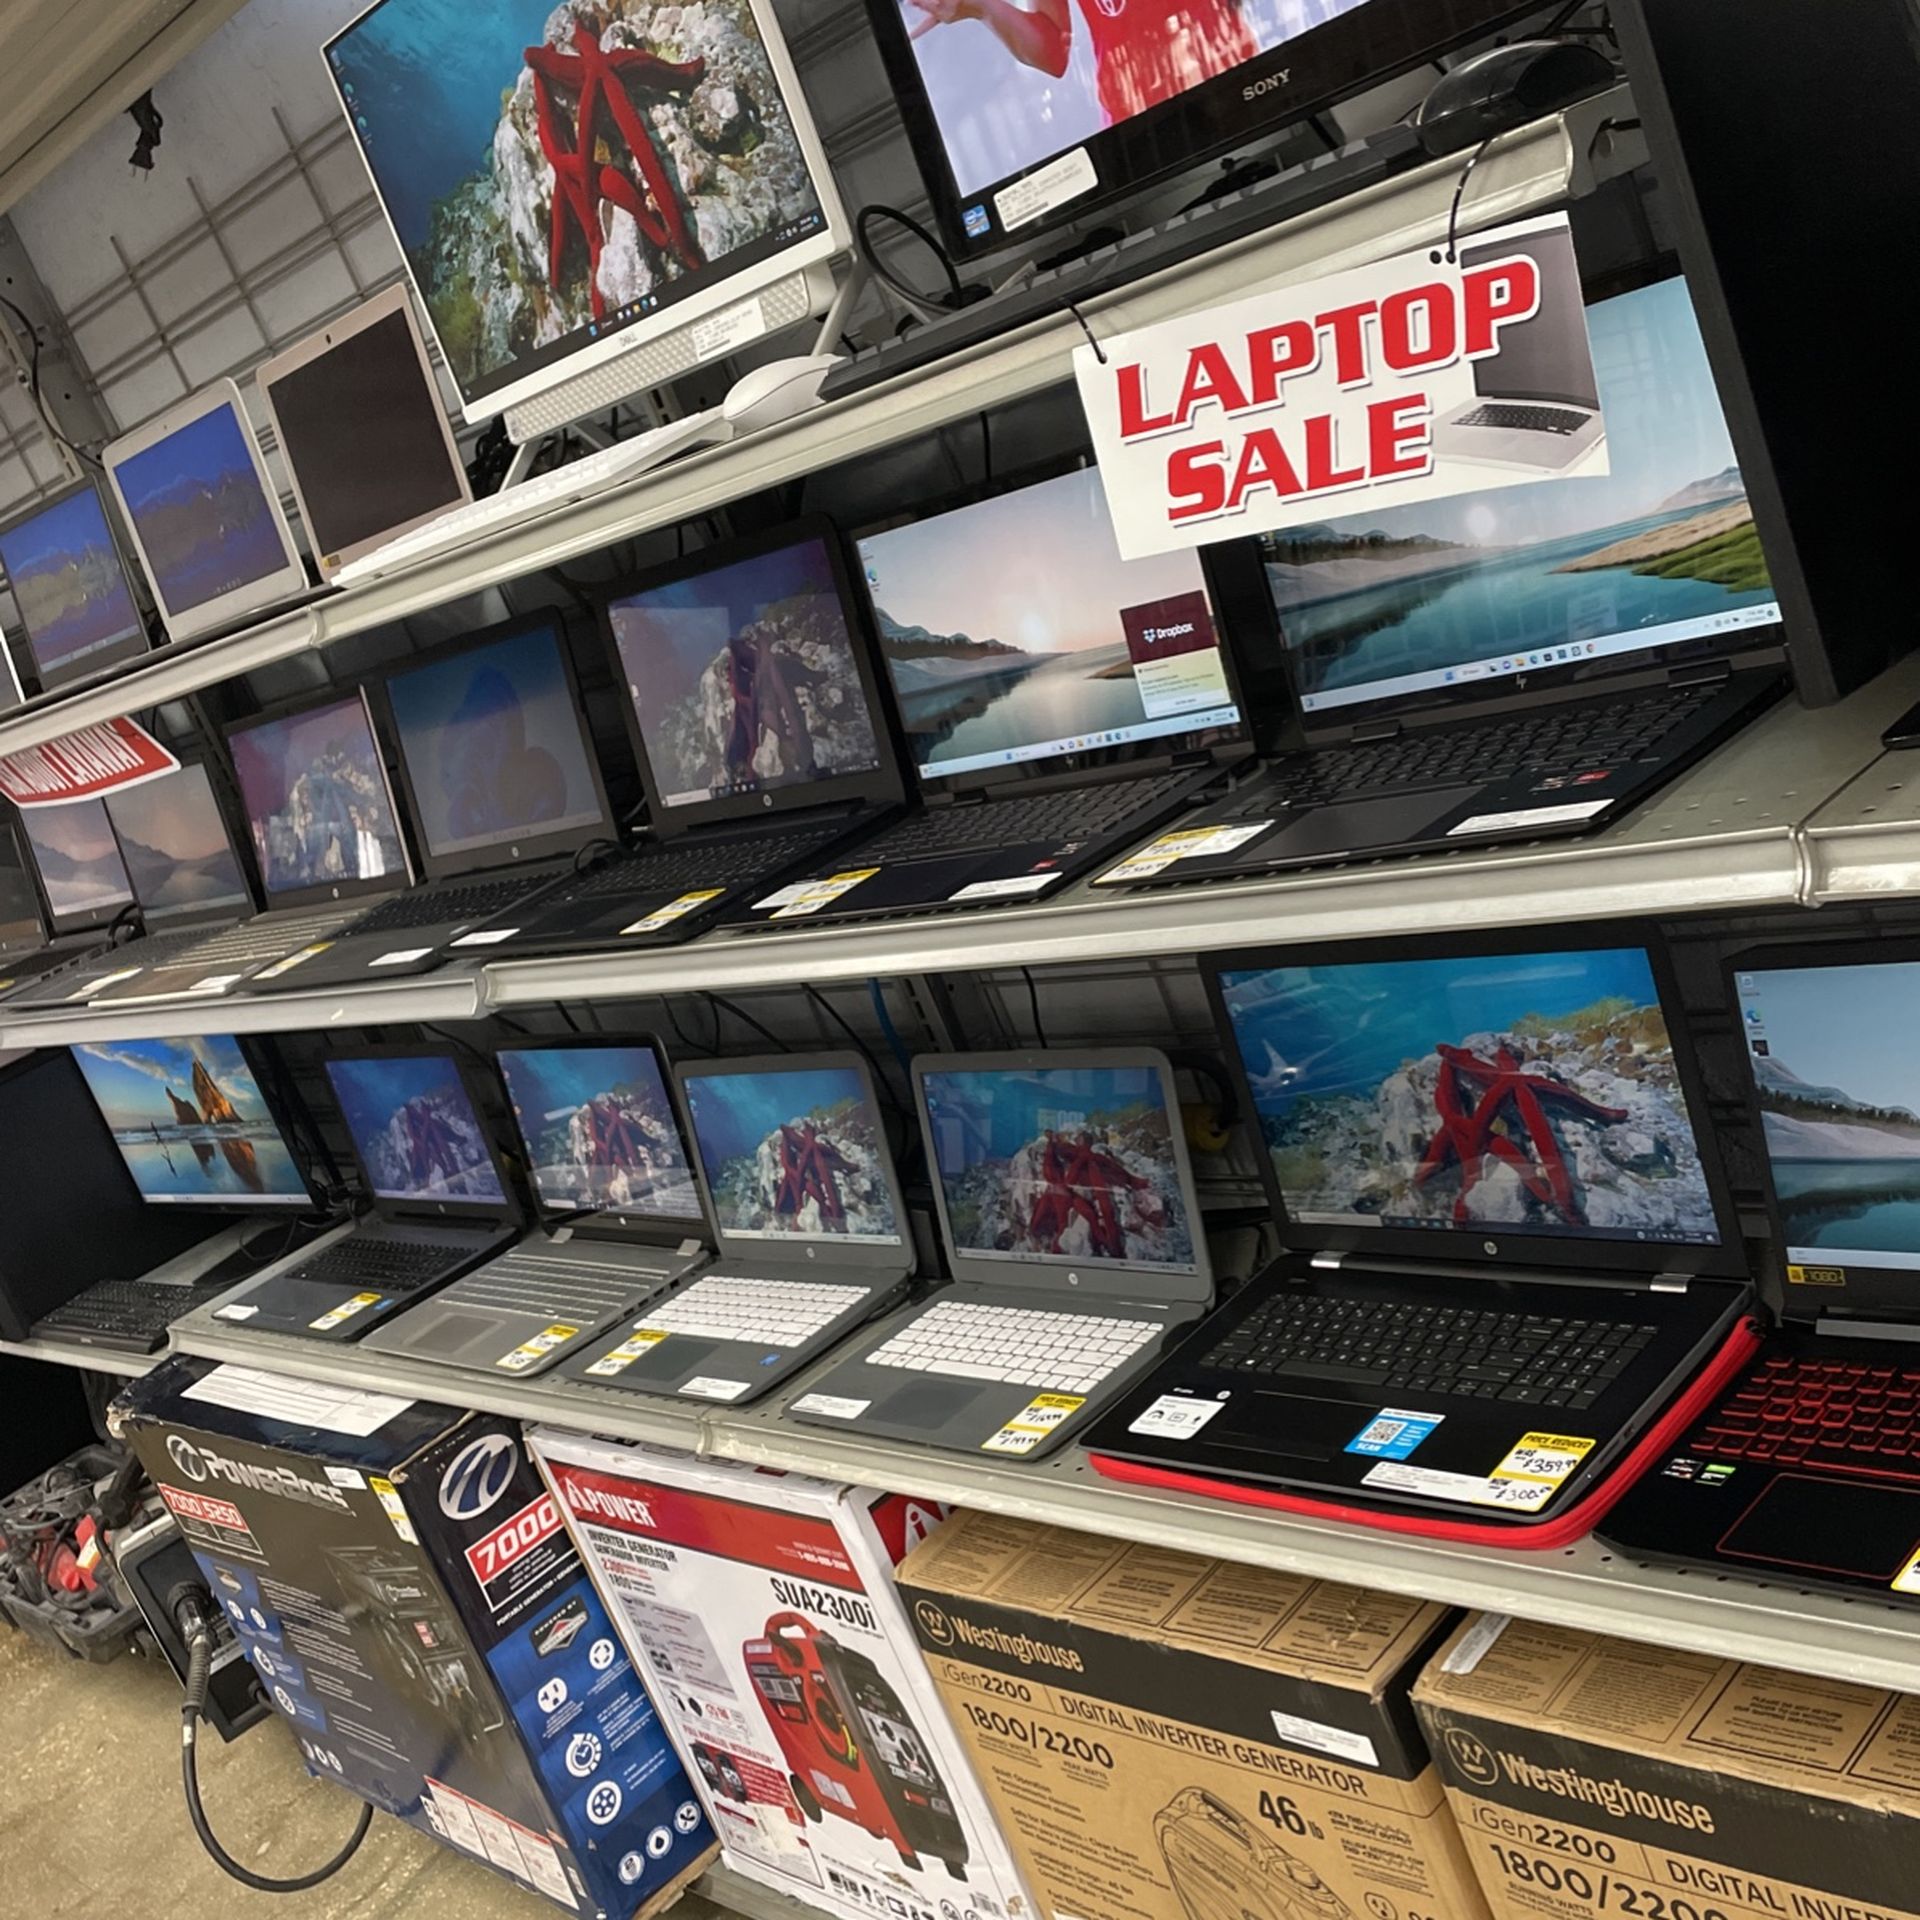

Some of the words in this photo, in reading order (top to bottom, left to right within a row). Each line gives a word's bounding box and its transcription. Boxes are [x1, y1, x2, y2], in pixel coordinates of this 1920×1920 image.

[1242, 68, 1291, 101] SONY
[1114, 259, 1539, 440] LAPTOP
[1166, 391, 1430, 522] SALE
[1156, 622, 1195, 640] Dropbox
[476, 1499, 560, 1574] 7000
[769, 1576, 877, 1631] SUA2300i
[950, 1616, 1085, 1673] Westinghouse
[942, 1661, 1032, 1703] iGen2200
[962, 1702, 1115, 1770] 1800/2200
[1060, 1695, 1133, 1731] DIGITAL
[1134, 1714, 1231, 1760] INVERTER
[1233, 1742, 1369, 1798] GENERATOR
[1258, 1789, 1307, 1837] 46
[1306, 1819, 1325, 1841] lb
[1497, 1749, 1716, 1835] Westinghouse
[1471, 1802, 1617, 1864] iGen2200
[1666, 1858, 1787, 1913] DIGITAL
